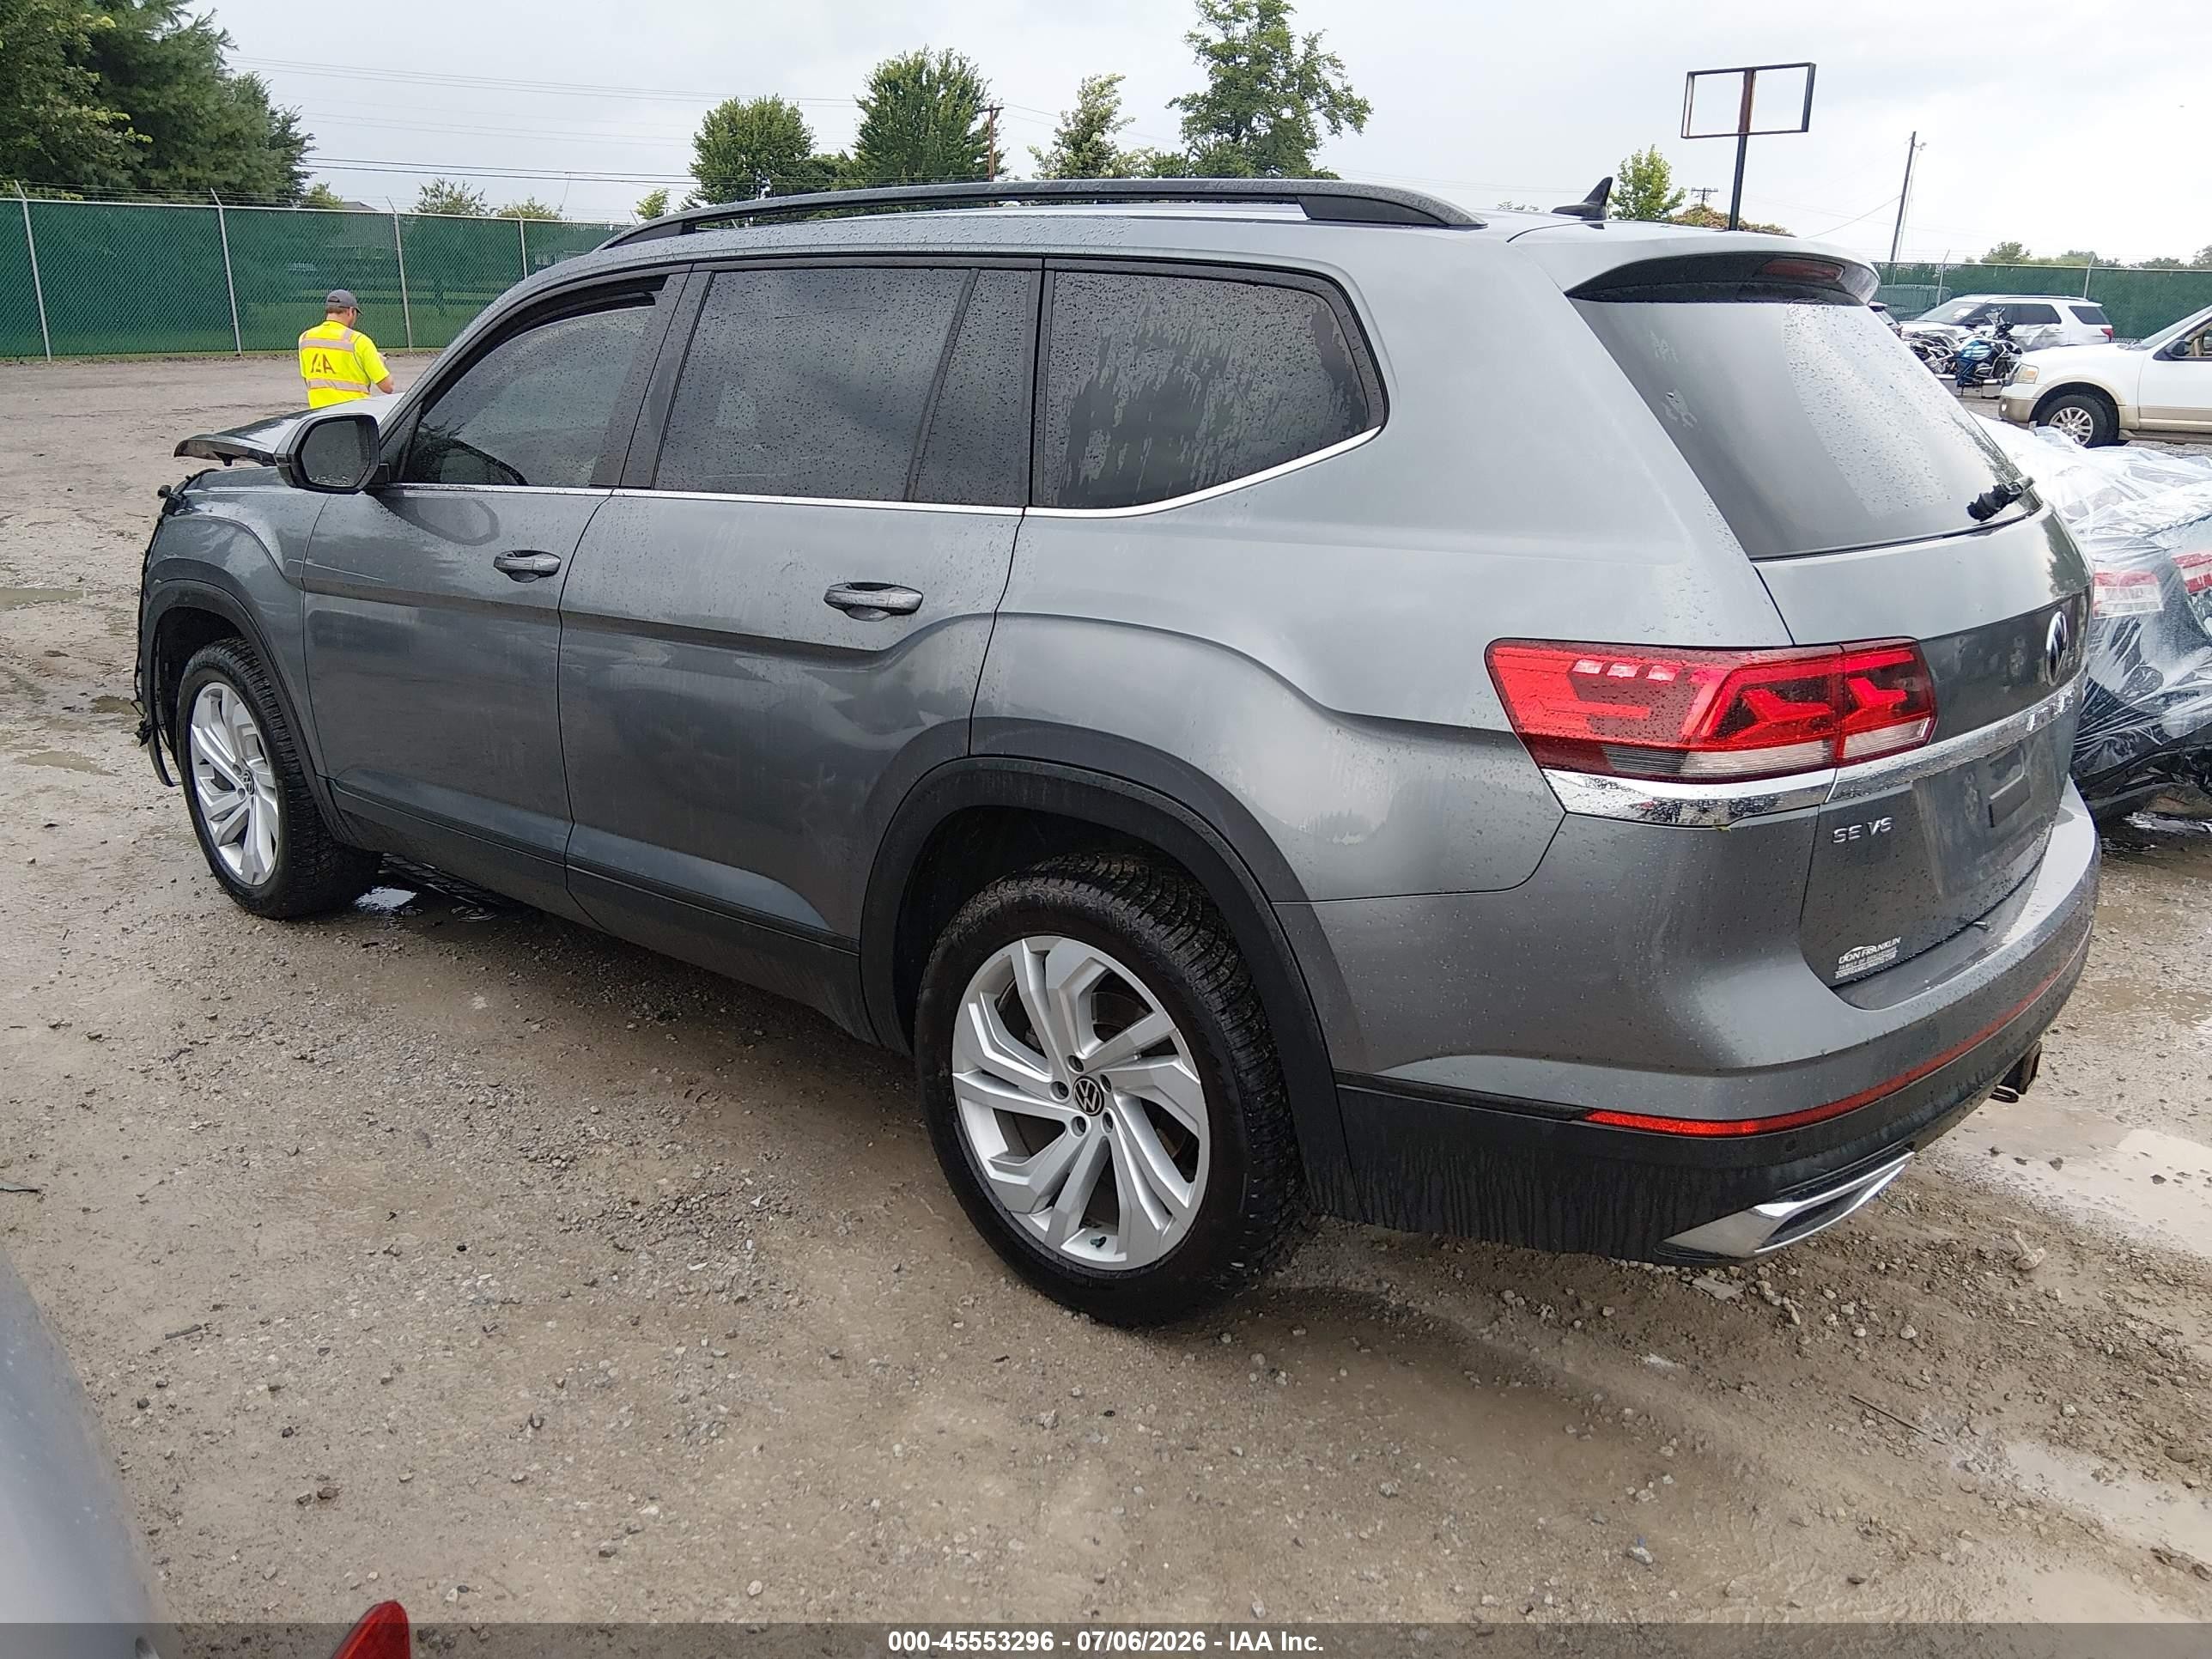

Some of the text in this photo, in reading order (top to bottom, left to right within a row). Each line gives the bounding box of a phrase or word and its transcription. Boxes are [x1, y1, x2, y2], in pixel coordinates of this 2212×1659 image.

[1832, 817, 1893, 843] SE V6
[1838, 951, 1862, 964] DON
[1073, 1079, 1102, 1114] VW
